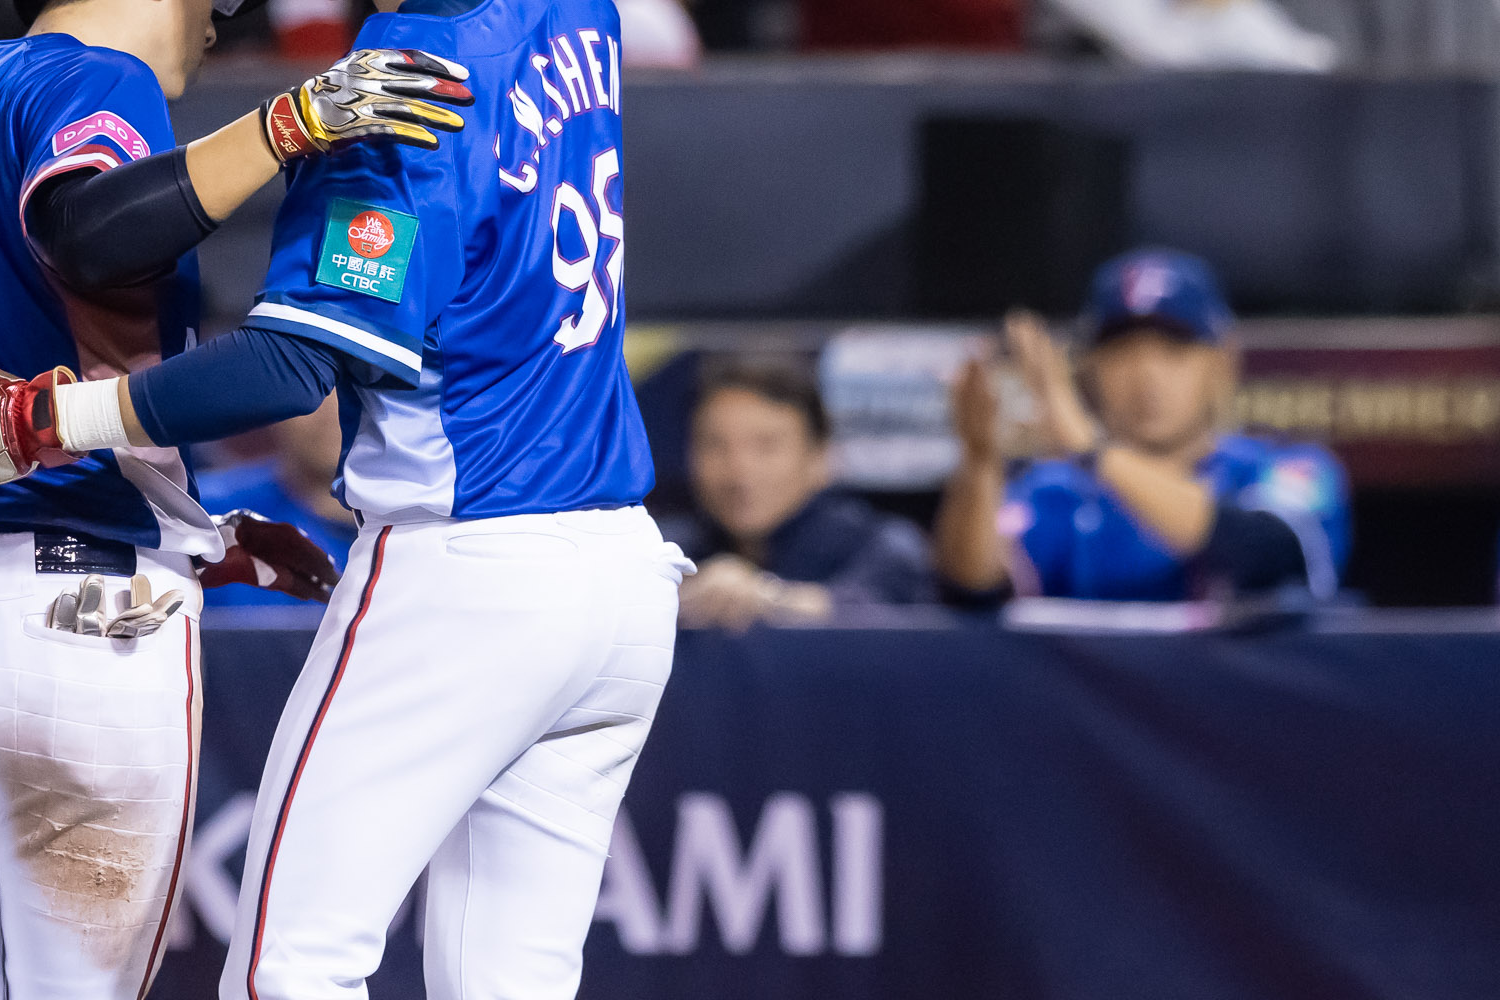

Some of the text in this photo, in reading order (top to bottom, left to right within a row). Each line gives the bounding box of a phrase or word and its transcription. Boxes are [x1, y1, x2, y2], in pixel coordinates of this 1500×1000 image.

[63, 118, 129, 142] DAISO
[331, 253, 396, 282] 中國信託
[341, 272, 381, 293] CTBC
